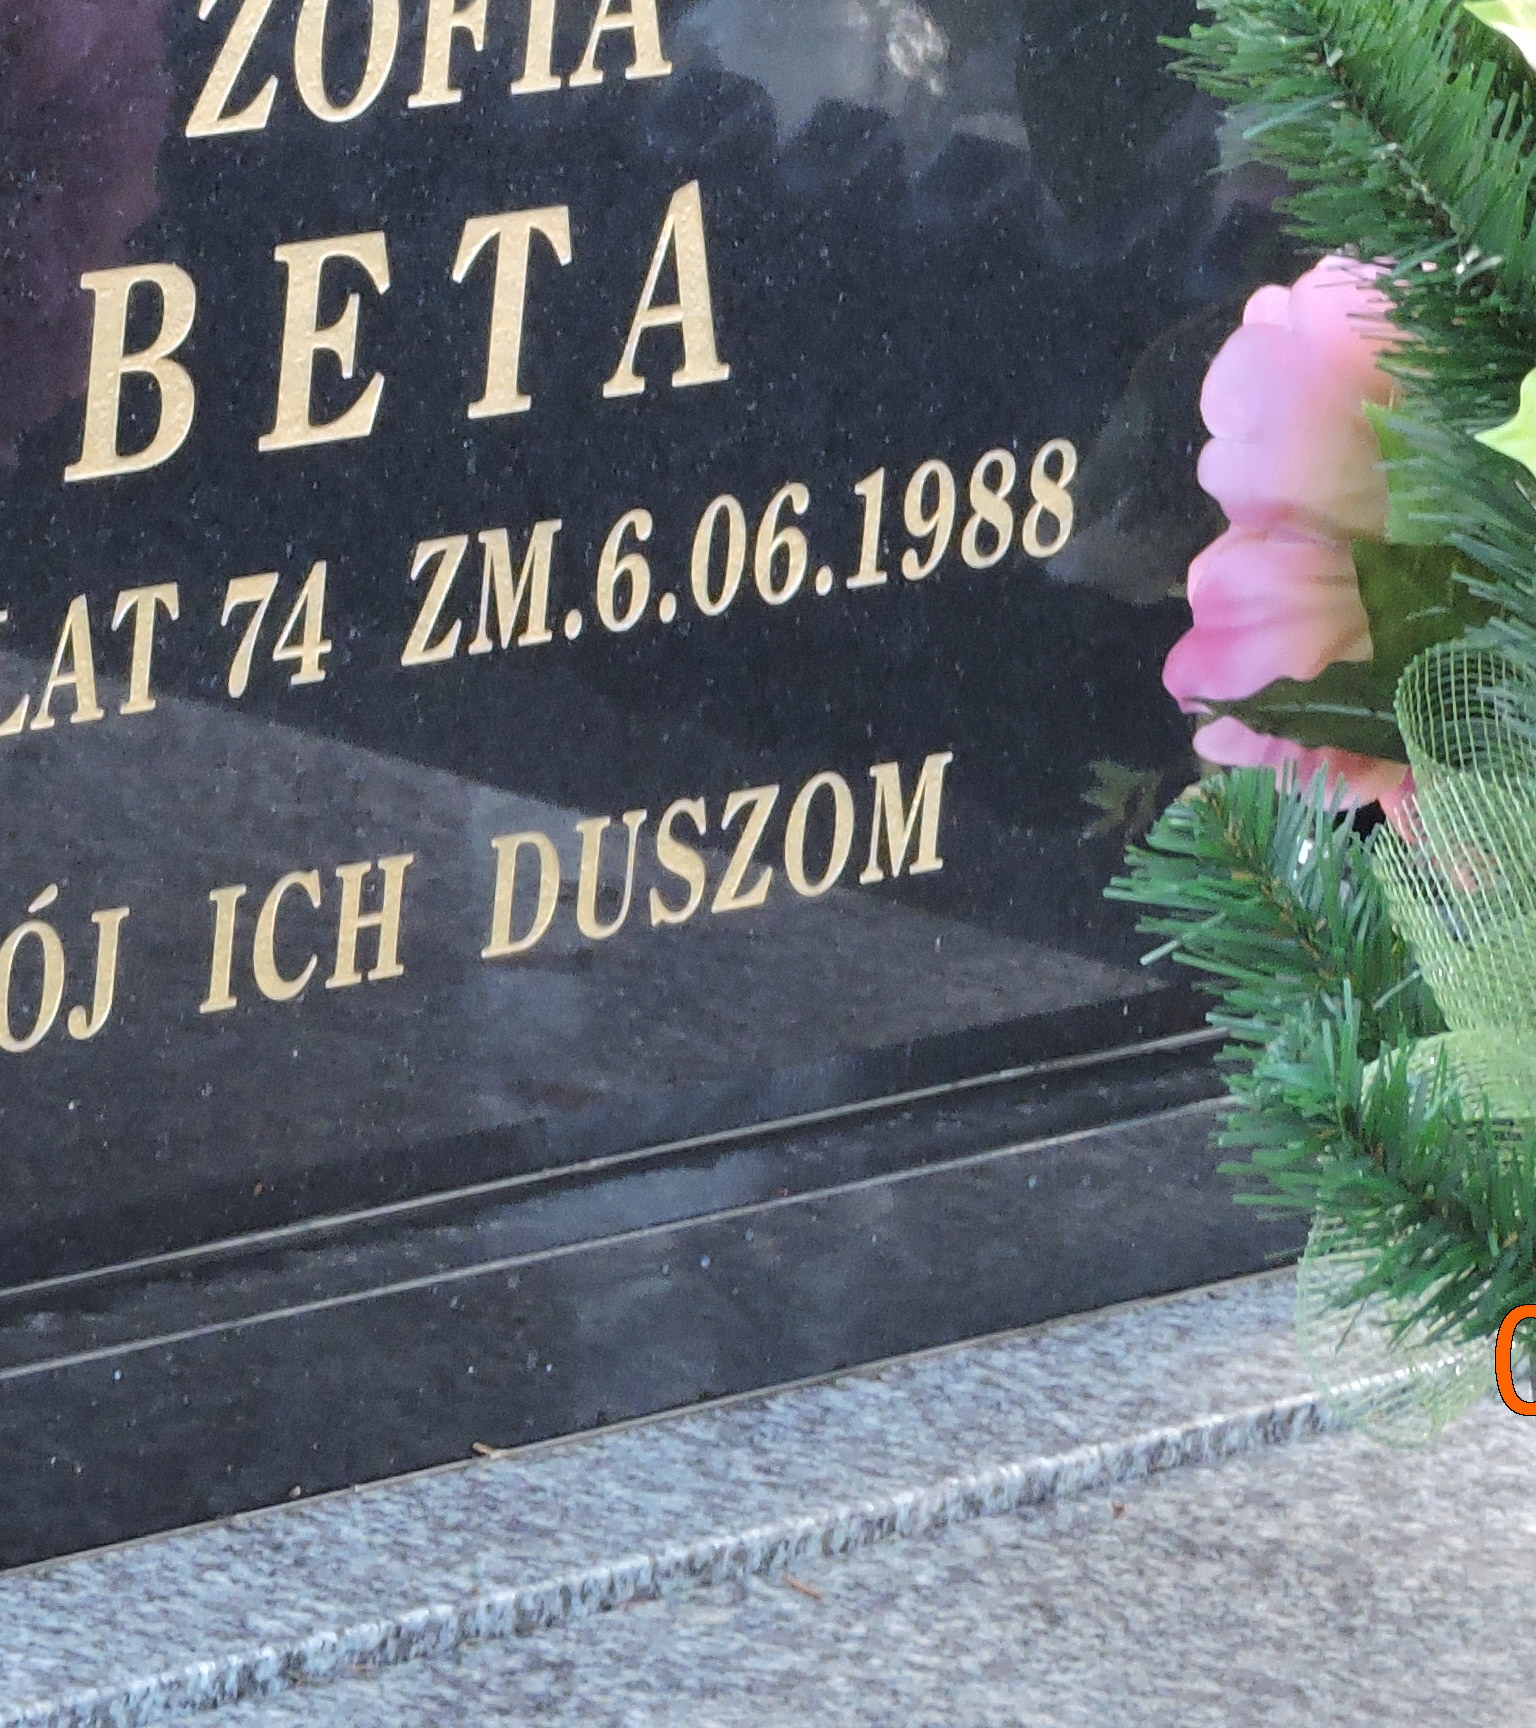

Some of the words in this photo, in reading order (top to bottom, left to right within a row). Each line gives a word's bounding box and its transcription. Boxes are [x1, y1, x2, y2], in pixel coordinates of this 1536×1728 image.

[63, 179, 730, 484] BETA
[223, 561, 333, 699] 74
[399, 437, 1080, 668] ZM.6.06.1988
[199, 852, 417, 1015] ICH
[482, 750, 954, 960] DUSZOM
